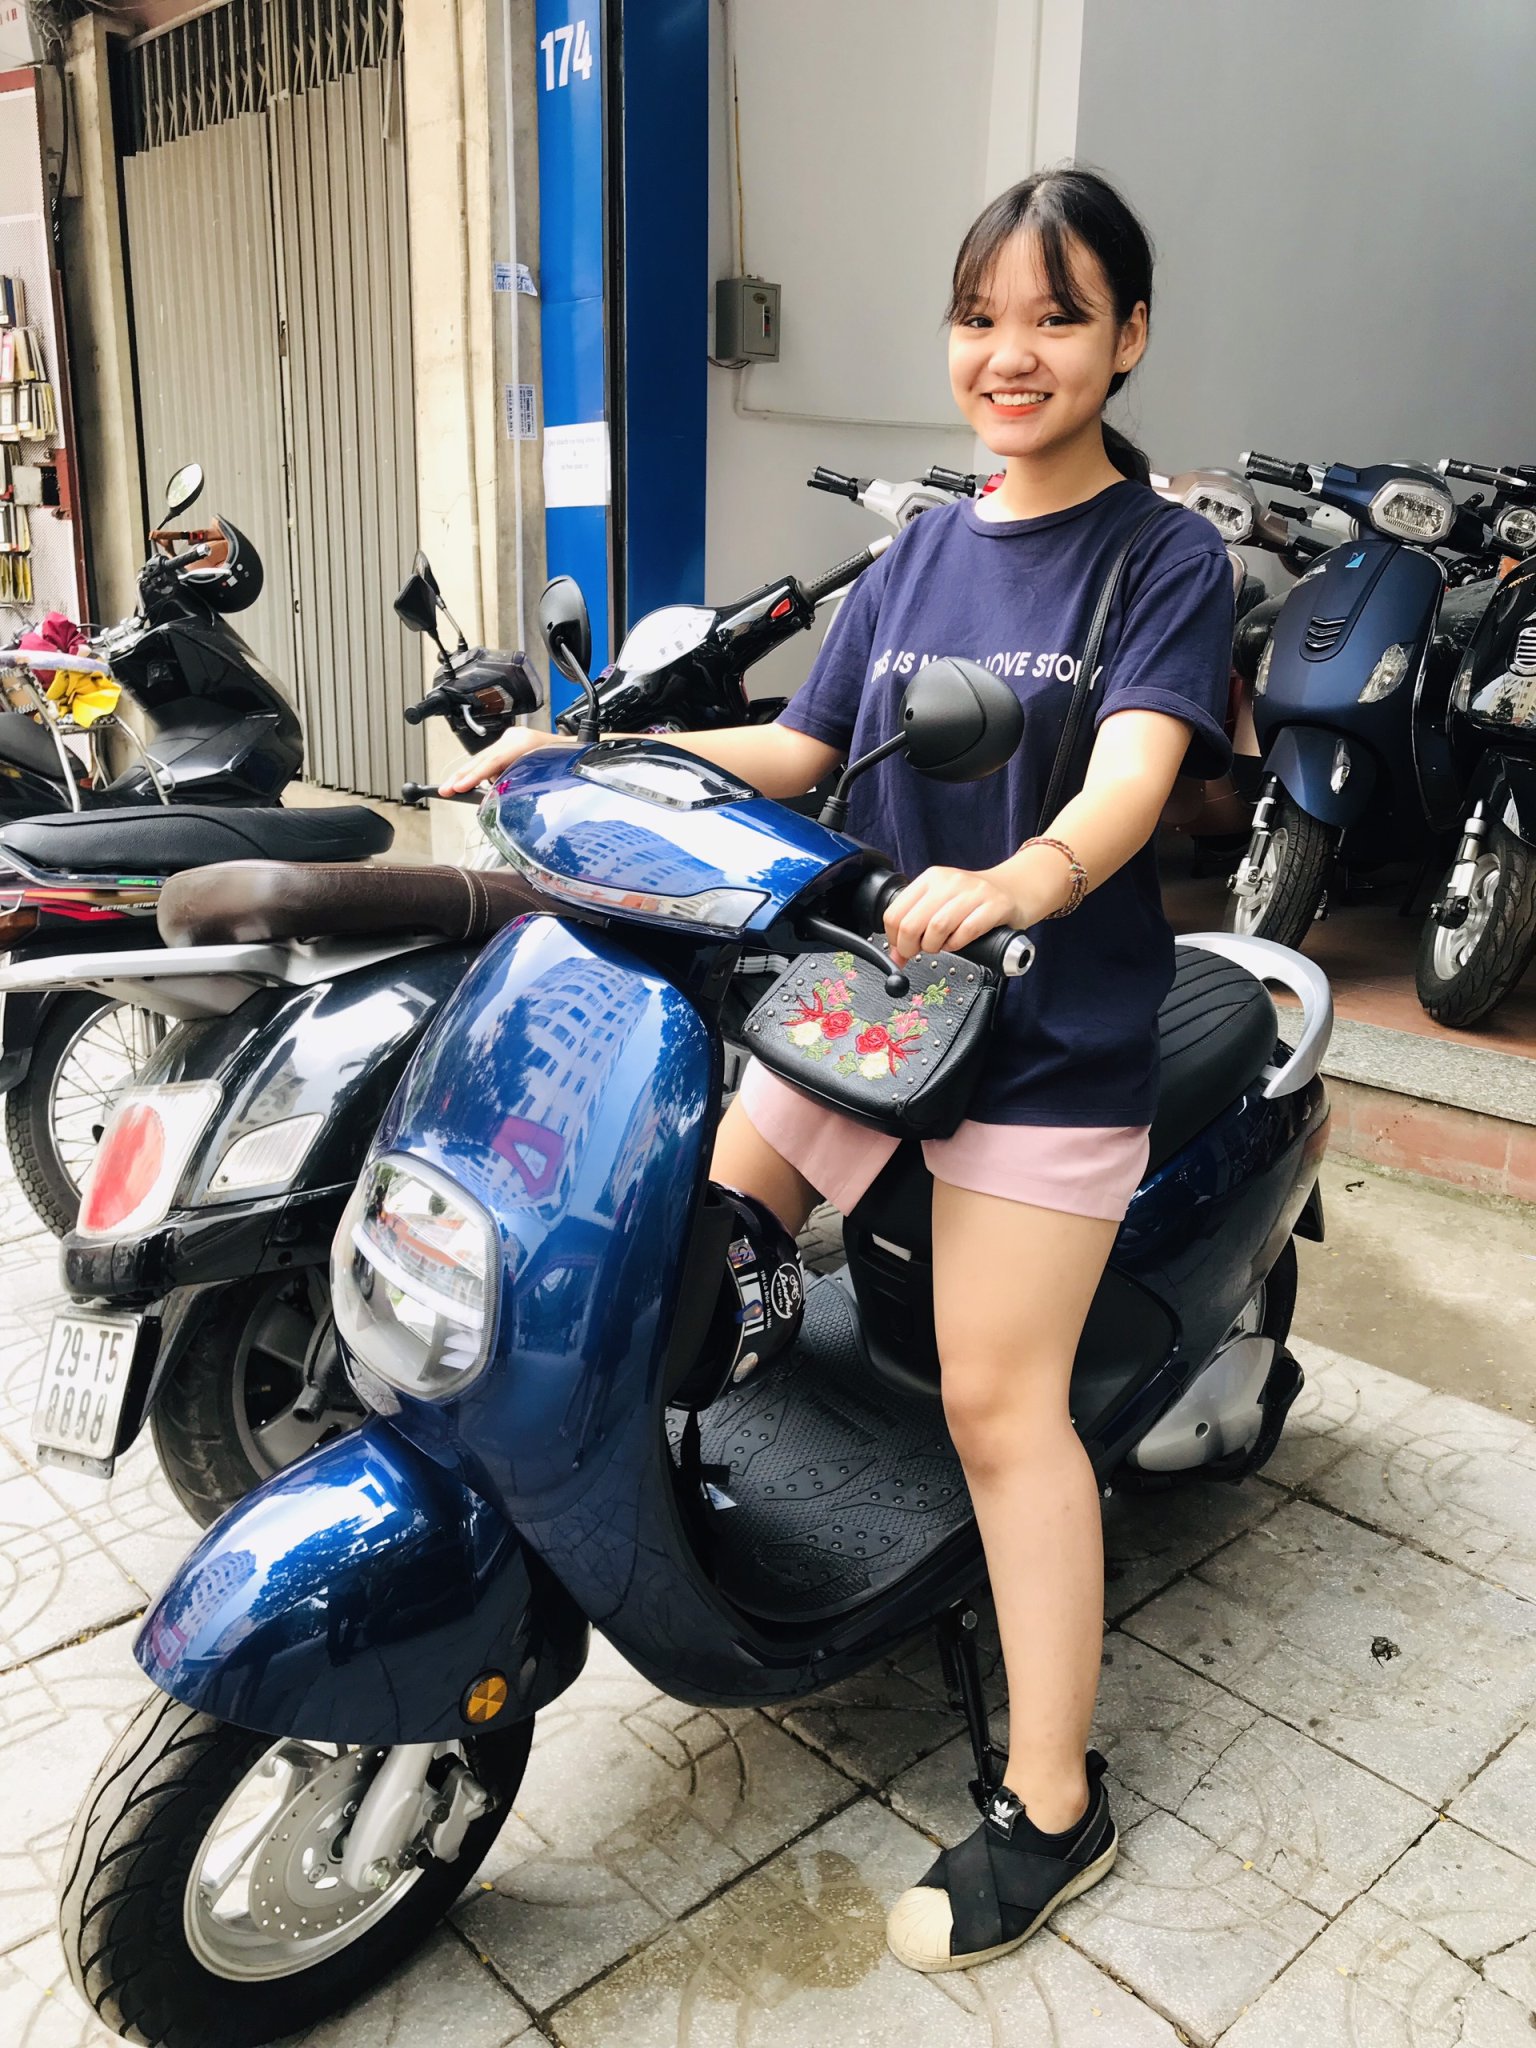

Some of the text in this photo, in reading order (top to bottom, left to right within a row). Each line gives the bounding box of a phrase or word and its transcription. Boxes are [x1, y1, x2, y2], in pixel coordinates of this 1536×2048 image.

[540, 20, 592, 91] 174
[893, 652, 914, 673] IS
[90, 904, 130, 912] ELECTRIC
[55, 1325, 123, 1384] 29-T5
[990, 1814, 1009, 1828] adidas
